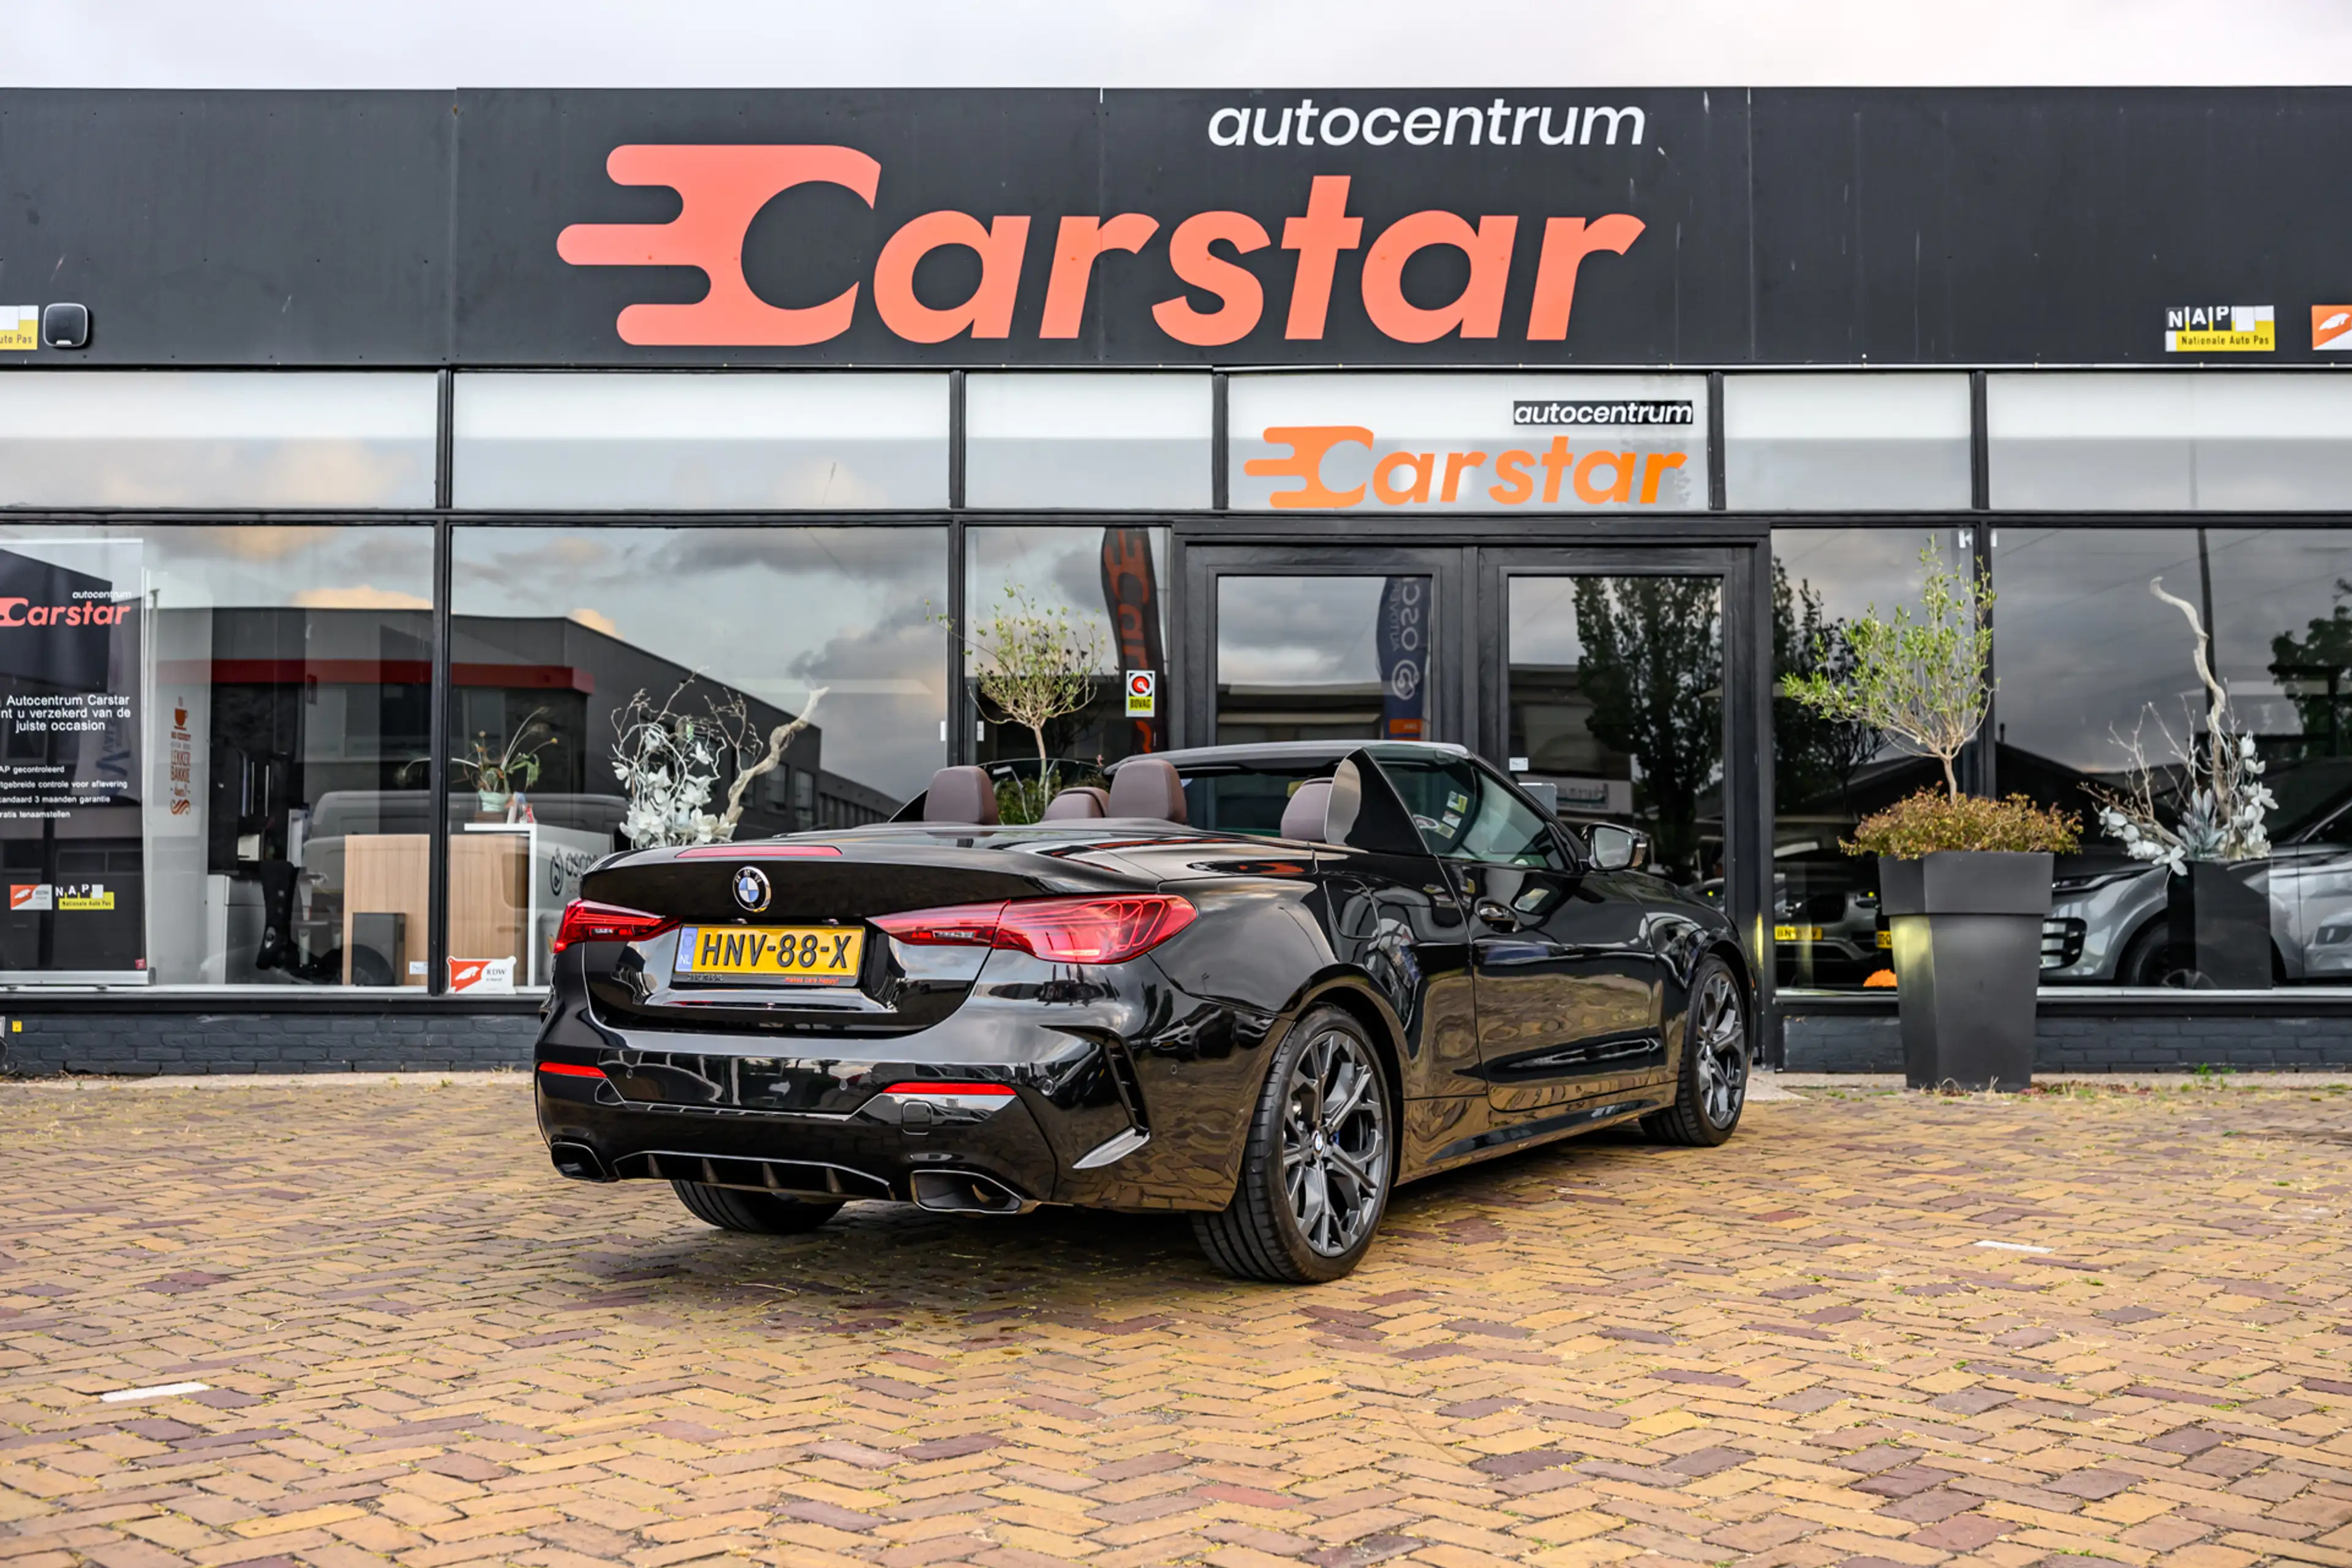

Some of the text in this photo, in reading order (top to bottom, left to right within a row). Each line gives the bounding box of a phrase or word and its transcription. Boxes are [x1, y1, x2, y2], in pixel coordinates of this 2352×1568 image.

[1208, 99, 1646, 147] autocentrum
[557, 145, 1646, 346] Carstar
[17, 333, 32, 344] Pas
[2181, 334, 2269, 345] Nationale Auto Pas
[1514, 402, 1692, 424] autocentrum
[1243, 426, 1688, 509] Carstar
[72, 590, 132, 599] autocentrum
[6, 695, 130, 706] Autocentrum Carstar
[1130, 698, 1151, 709] BOVAG
[17, 710, 25, 718] u
[29, 707, 88, 718] verzekerd
[92, 709, 112, 718] van
[116, 707, 131, 718] de
[15, 720, 105, 734] juiste occasion
[13, 766, 65, 775] gecontroleerd
[38, 780, 69, 789] controle
[91, 780, 128, 790] aflevering
[79, 796, 111, 805] garantie
[55, 884, 90, 897] NAP
[701, 933, 852, 969] HNV-88-X
[678, 954, 691, 965] NL
